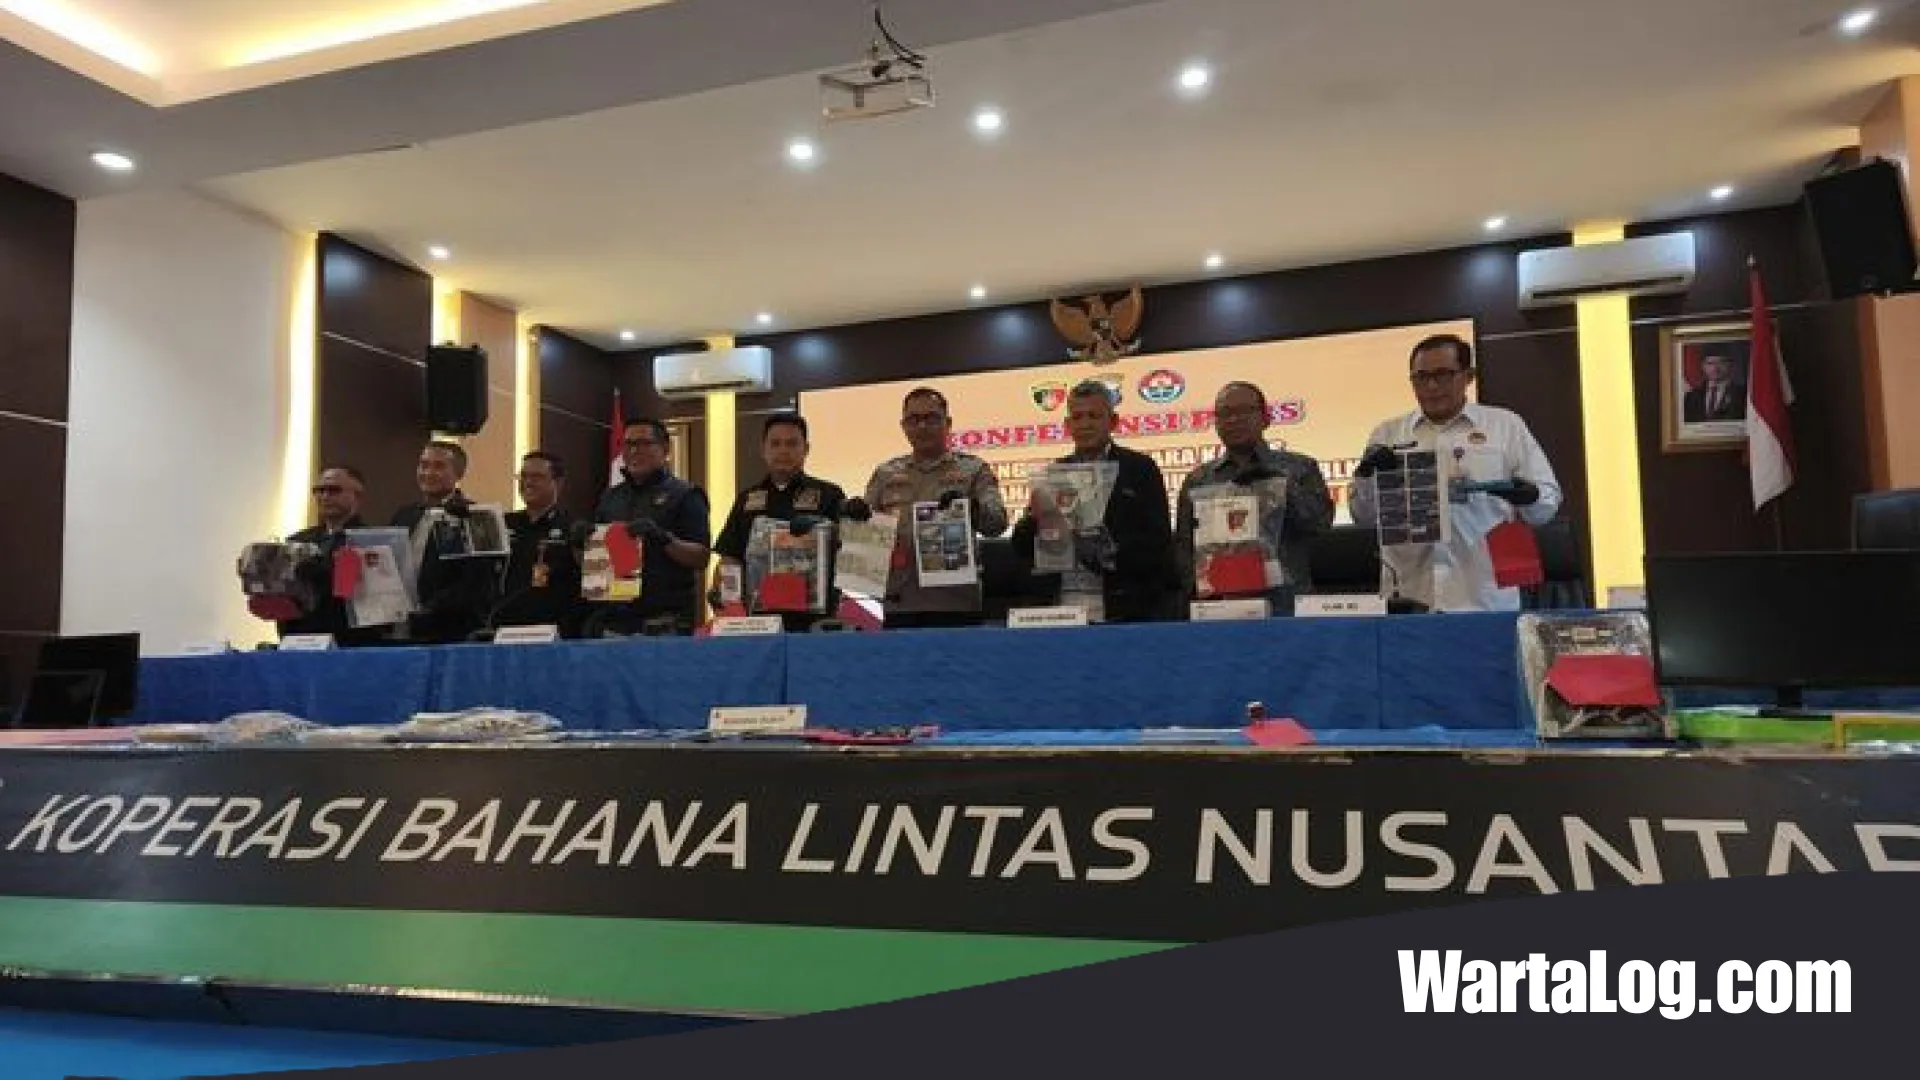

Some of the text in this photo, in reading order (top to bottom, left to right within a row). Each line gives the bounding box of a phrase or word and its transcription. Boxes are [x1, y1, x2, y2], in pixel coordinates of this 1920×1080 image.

[944, 412, 1181, 447] ONFENSI
[6, 795, 384, 858] KOPERASI
[380, 798, 746, 869] BAHANA
[782, 804, 1152, 880] LINTAS
